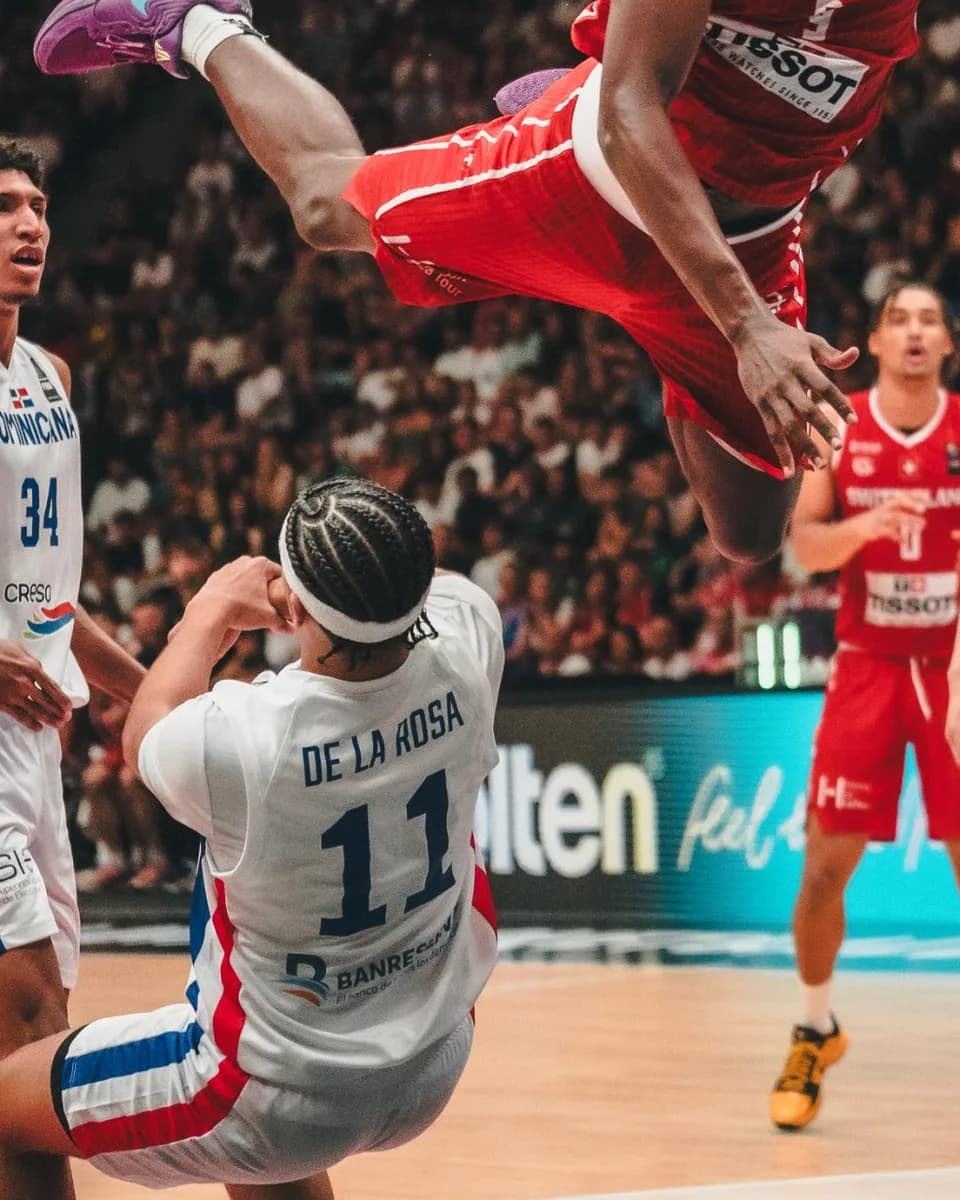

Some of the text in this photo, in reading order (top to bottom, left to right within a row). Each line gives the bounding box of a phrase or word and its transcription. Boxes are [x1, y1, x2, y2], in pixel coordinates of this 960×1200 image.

[728, 51, 778, 89] WATCHES
[778, 85, 811, 109] SINCE
[20, 477, 59, 548] 34
[869, 593, 955, 614] TISSOT
[302, 691, 465, 788] DE LA ROSA
[319, 768, 457, 937] 11
[474, 744, 658, 878] lten
